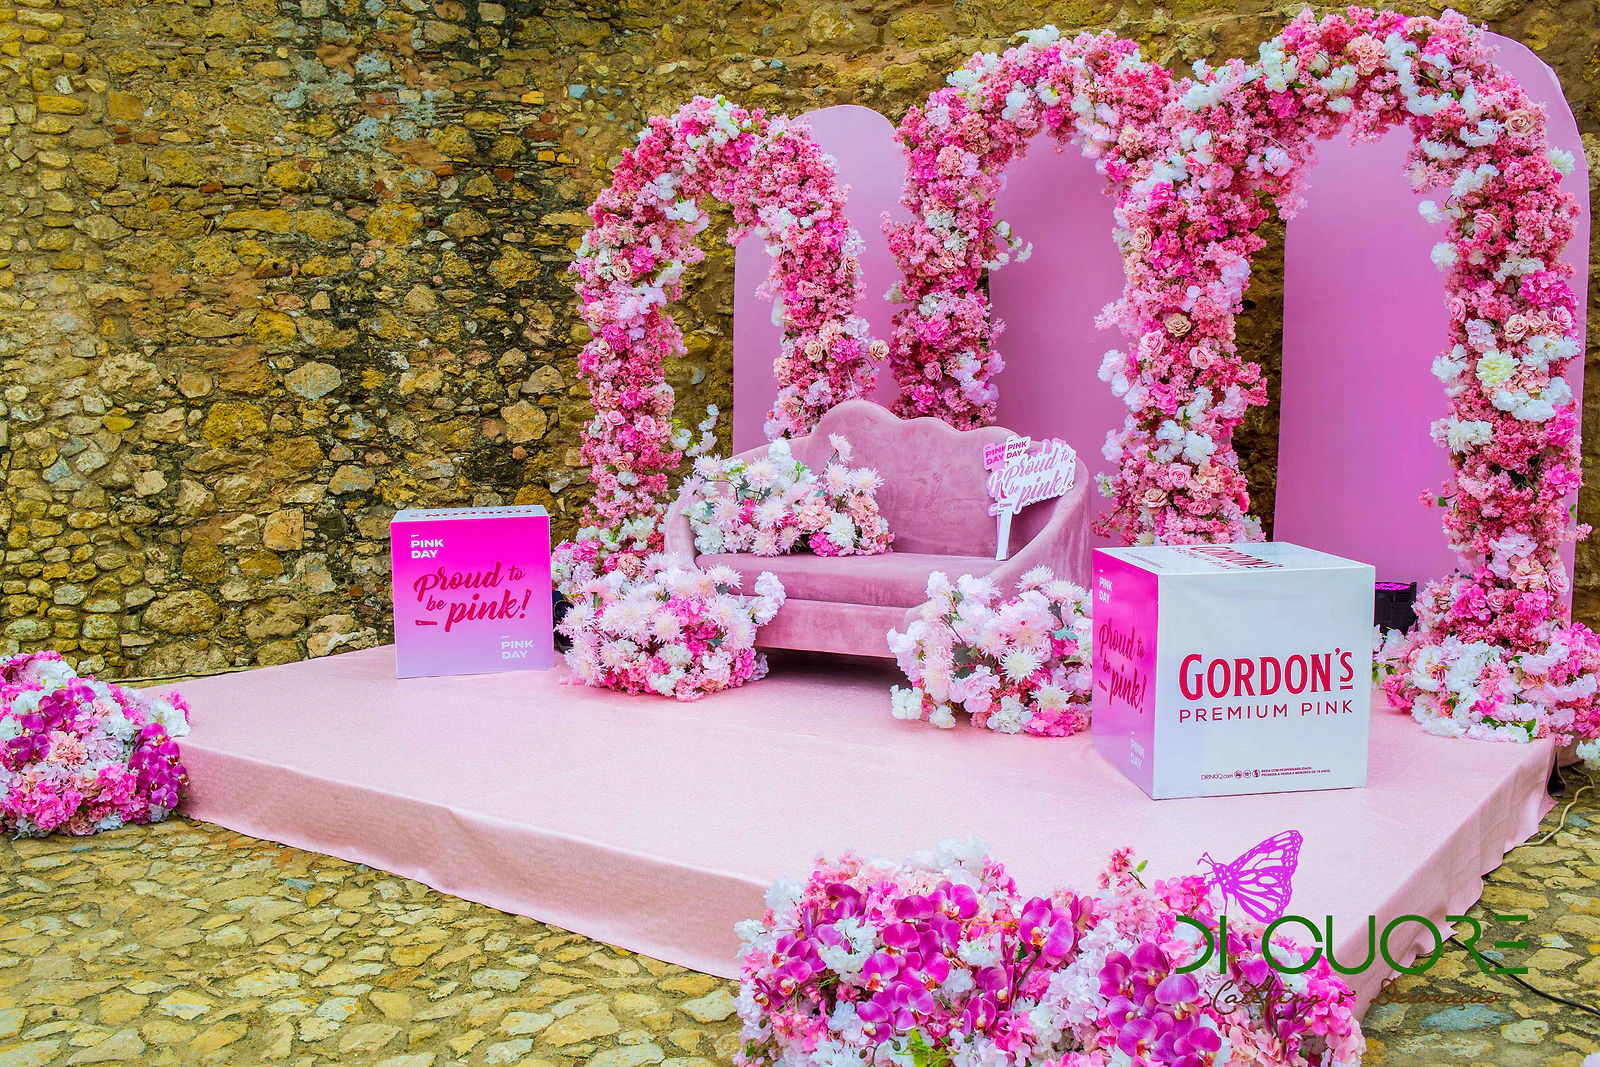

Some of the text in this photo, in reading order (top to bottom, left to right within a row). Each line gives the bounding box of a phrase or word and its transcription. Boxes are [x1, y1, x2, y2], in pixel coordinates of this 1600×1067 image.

[1006, 450, 1022, 459] DAY
[1007, 441, 1027, 451] PINK
[986, 453, 1004, 465] DAY
[1004, 447, 1070, 488] Proud to
[1008, 466, 1072, 512] be pink!
[410, 539, 444, 548] PINK
[411, 550, 438, 559] DAY
[413, 561, 527, 602] Proud to
[1100, 576, 1112, 592] PINK
[1099, 589, 1110, 604] DAY
[425, 588, 532, 633] be pink!
[501, 640, 534, 649] PINK
[1136, 636, 1145, 659] to
[501, 651, 528, 660] DAY
[1102, 652, 1147, 714] be pink!
[1179, 647, 1354, 701] GORDON'S
[1179, 700, 1353, 723] PREMIUM PINK
[1130, 738, 1145, 759] PINK
[1130, 752, 1143, 770] DAY
